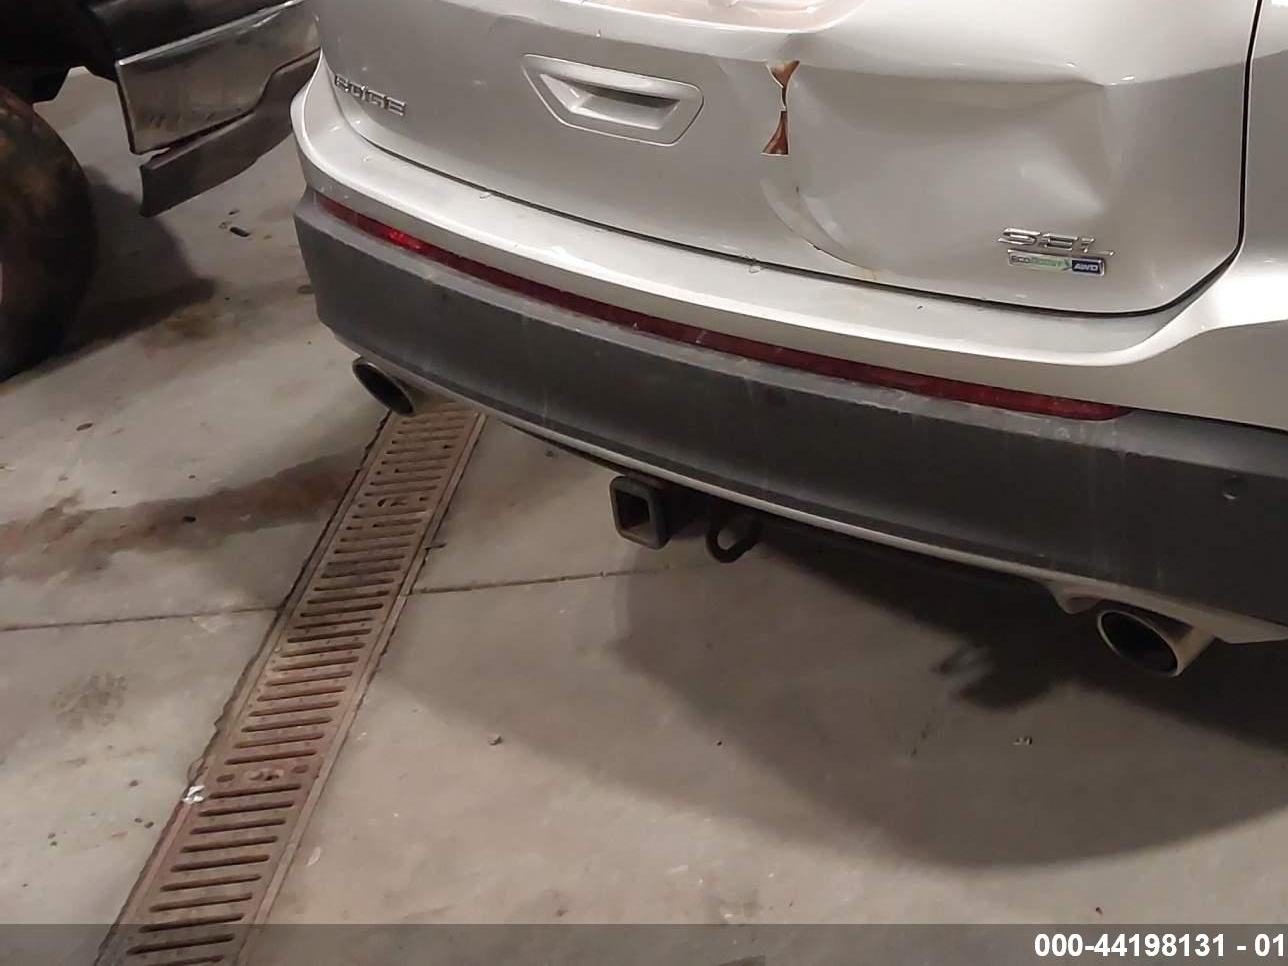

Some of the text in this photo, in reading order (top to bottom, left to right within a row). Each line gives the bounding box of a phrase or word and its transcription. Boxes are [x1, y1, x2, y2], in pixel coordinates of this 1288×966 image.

[334, 73, 405, 116] EDGE
[998, 227, 1115, 256] SEL
[1074, 263, 1099, 272] AWD
